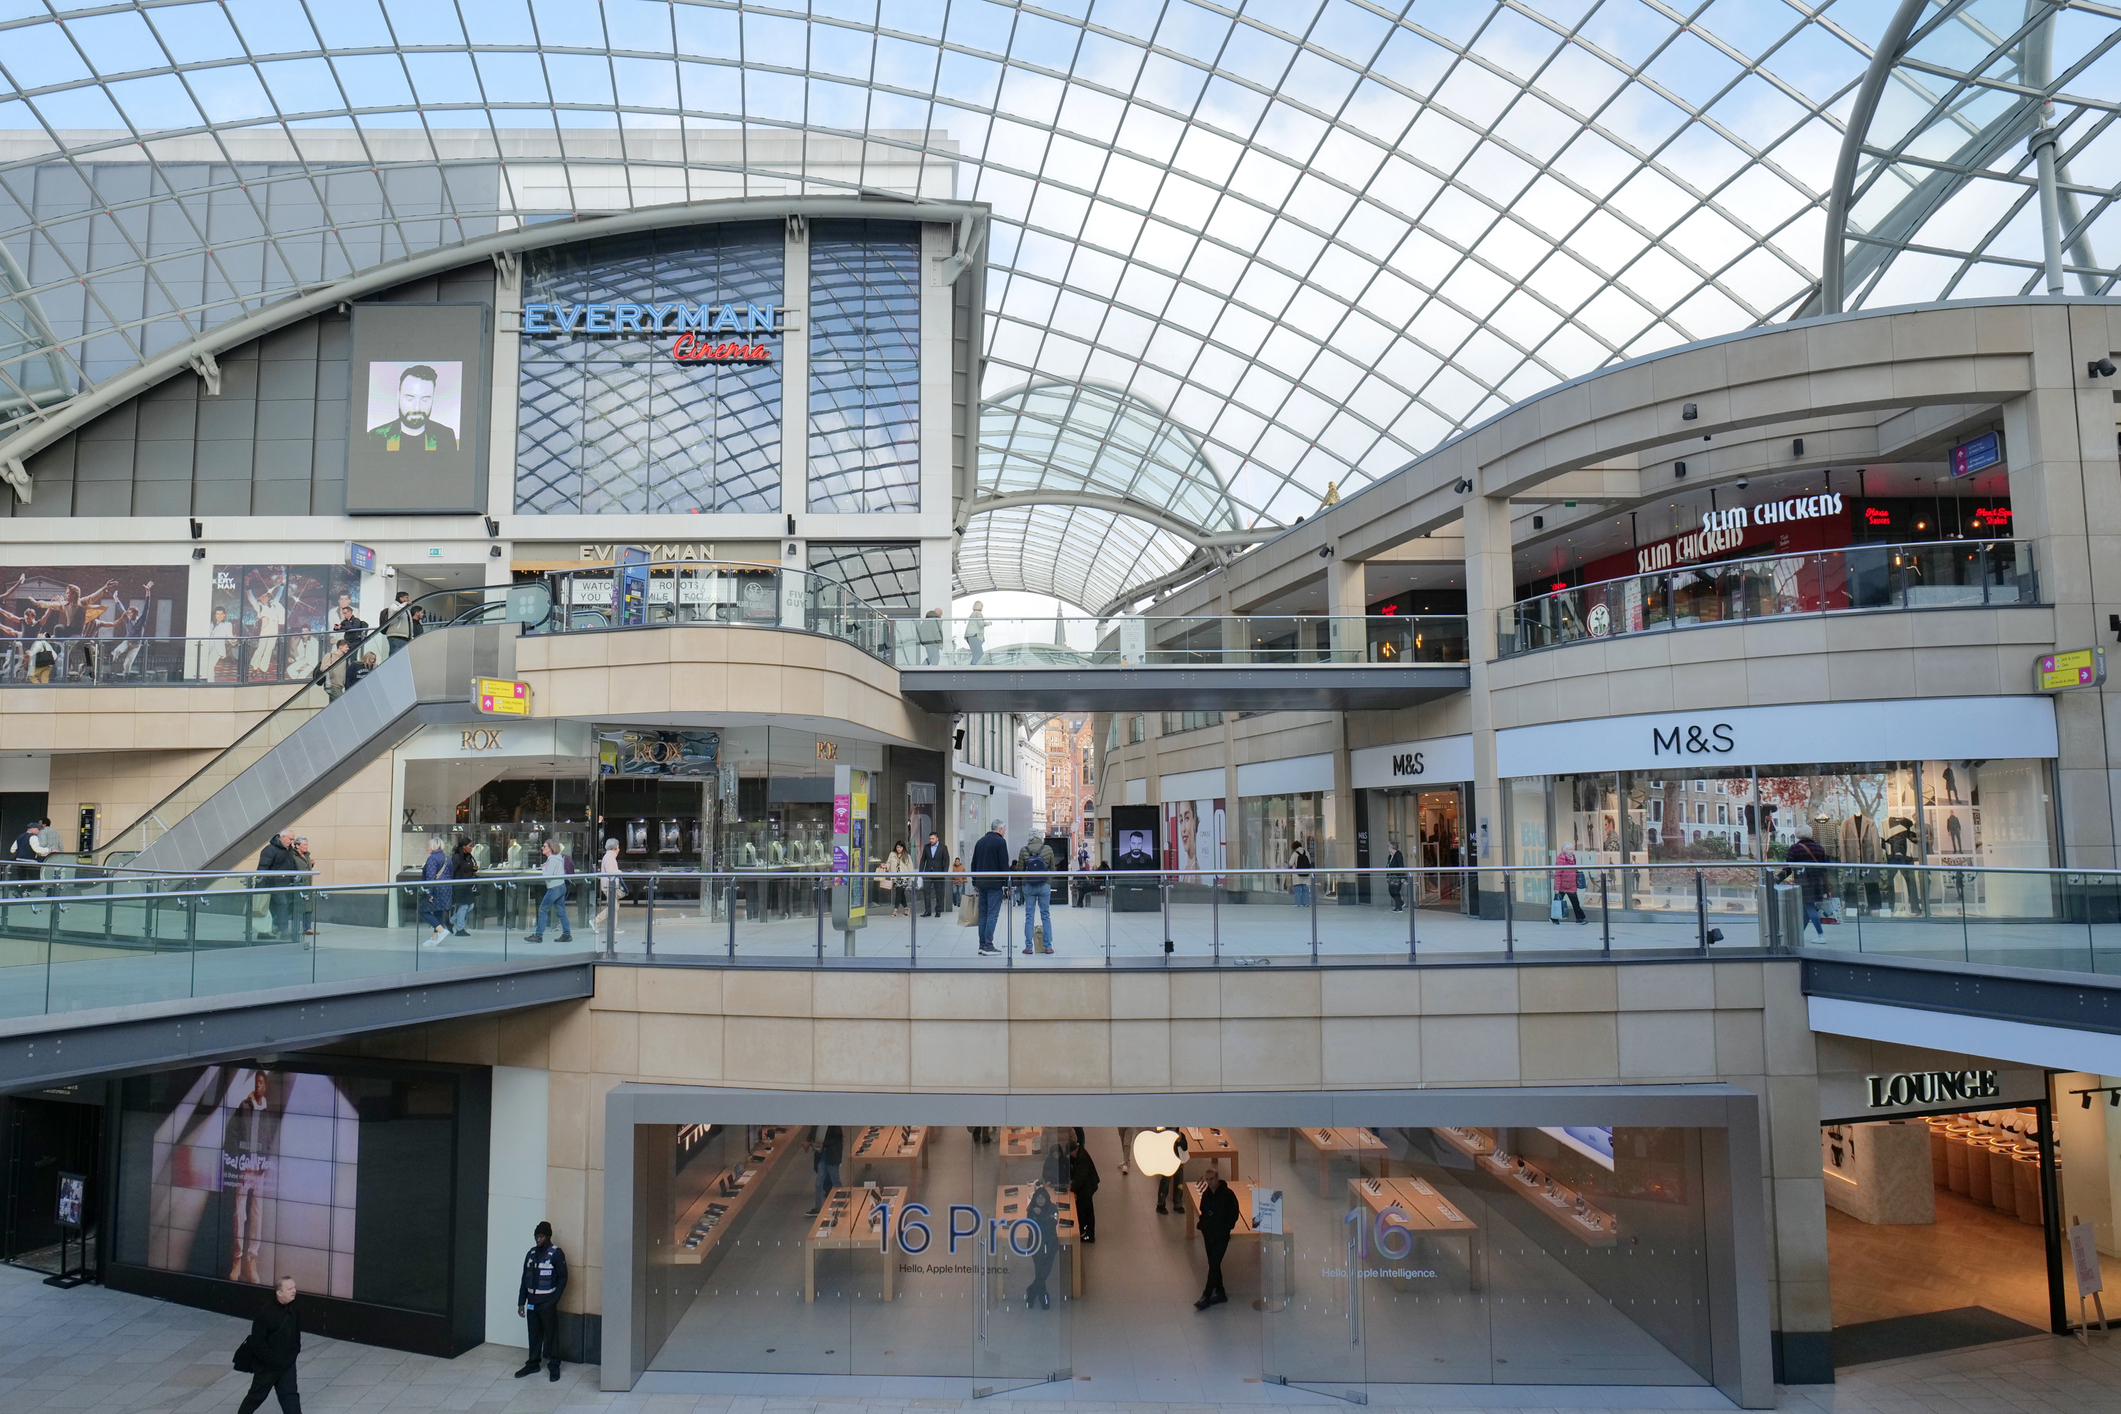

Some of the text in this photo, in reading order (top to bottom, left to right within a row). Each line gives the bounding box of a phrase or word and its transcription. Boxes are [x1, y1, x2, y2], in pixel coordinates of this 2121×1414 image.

[524, 303, 774, 333] EVERYMAN
[672, 333, 770, 361] Cinema
[1702, 492, 1843, 533] SLIM CHICKENS
[1865, 507, 1889, 518] House
[1869, 516, 1891, 525] Sauces
[579, 544, 715, 561] EVYMAN
[1637, 542, 1672, 574] SLIM
[1676, 527, 1744, 563] CHICKENS
[580, 593, 601, 601] YOU
[460, 728, 503, 751] ROX
[816, 741, 838, 760] ROX
[1653, 723, 1735, 756] M&S
[631, 741, 687, 764] ROX
[1392, 752, 1425, 776] M&S
[1520, 821, 1546, 848] BIG
[1867, 1070, 2000, 1108] LOUNGE
[868, 1202, 1042, 1257] 16 Pro
[1344, 1206, 1413, 1260] 16
[899, 1264, 1011, 1276] Hello, Apple Intelligence.
[1322, 1268, 1349, 1278] Hello,
[1380, 1268, 1438, 1279] Intelligence.
